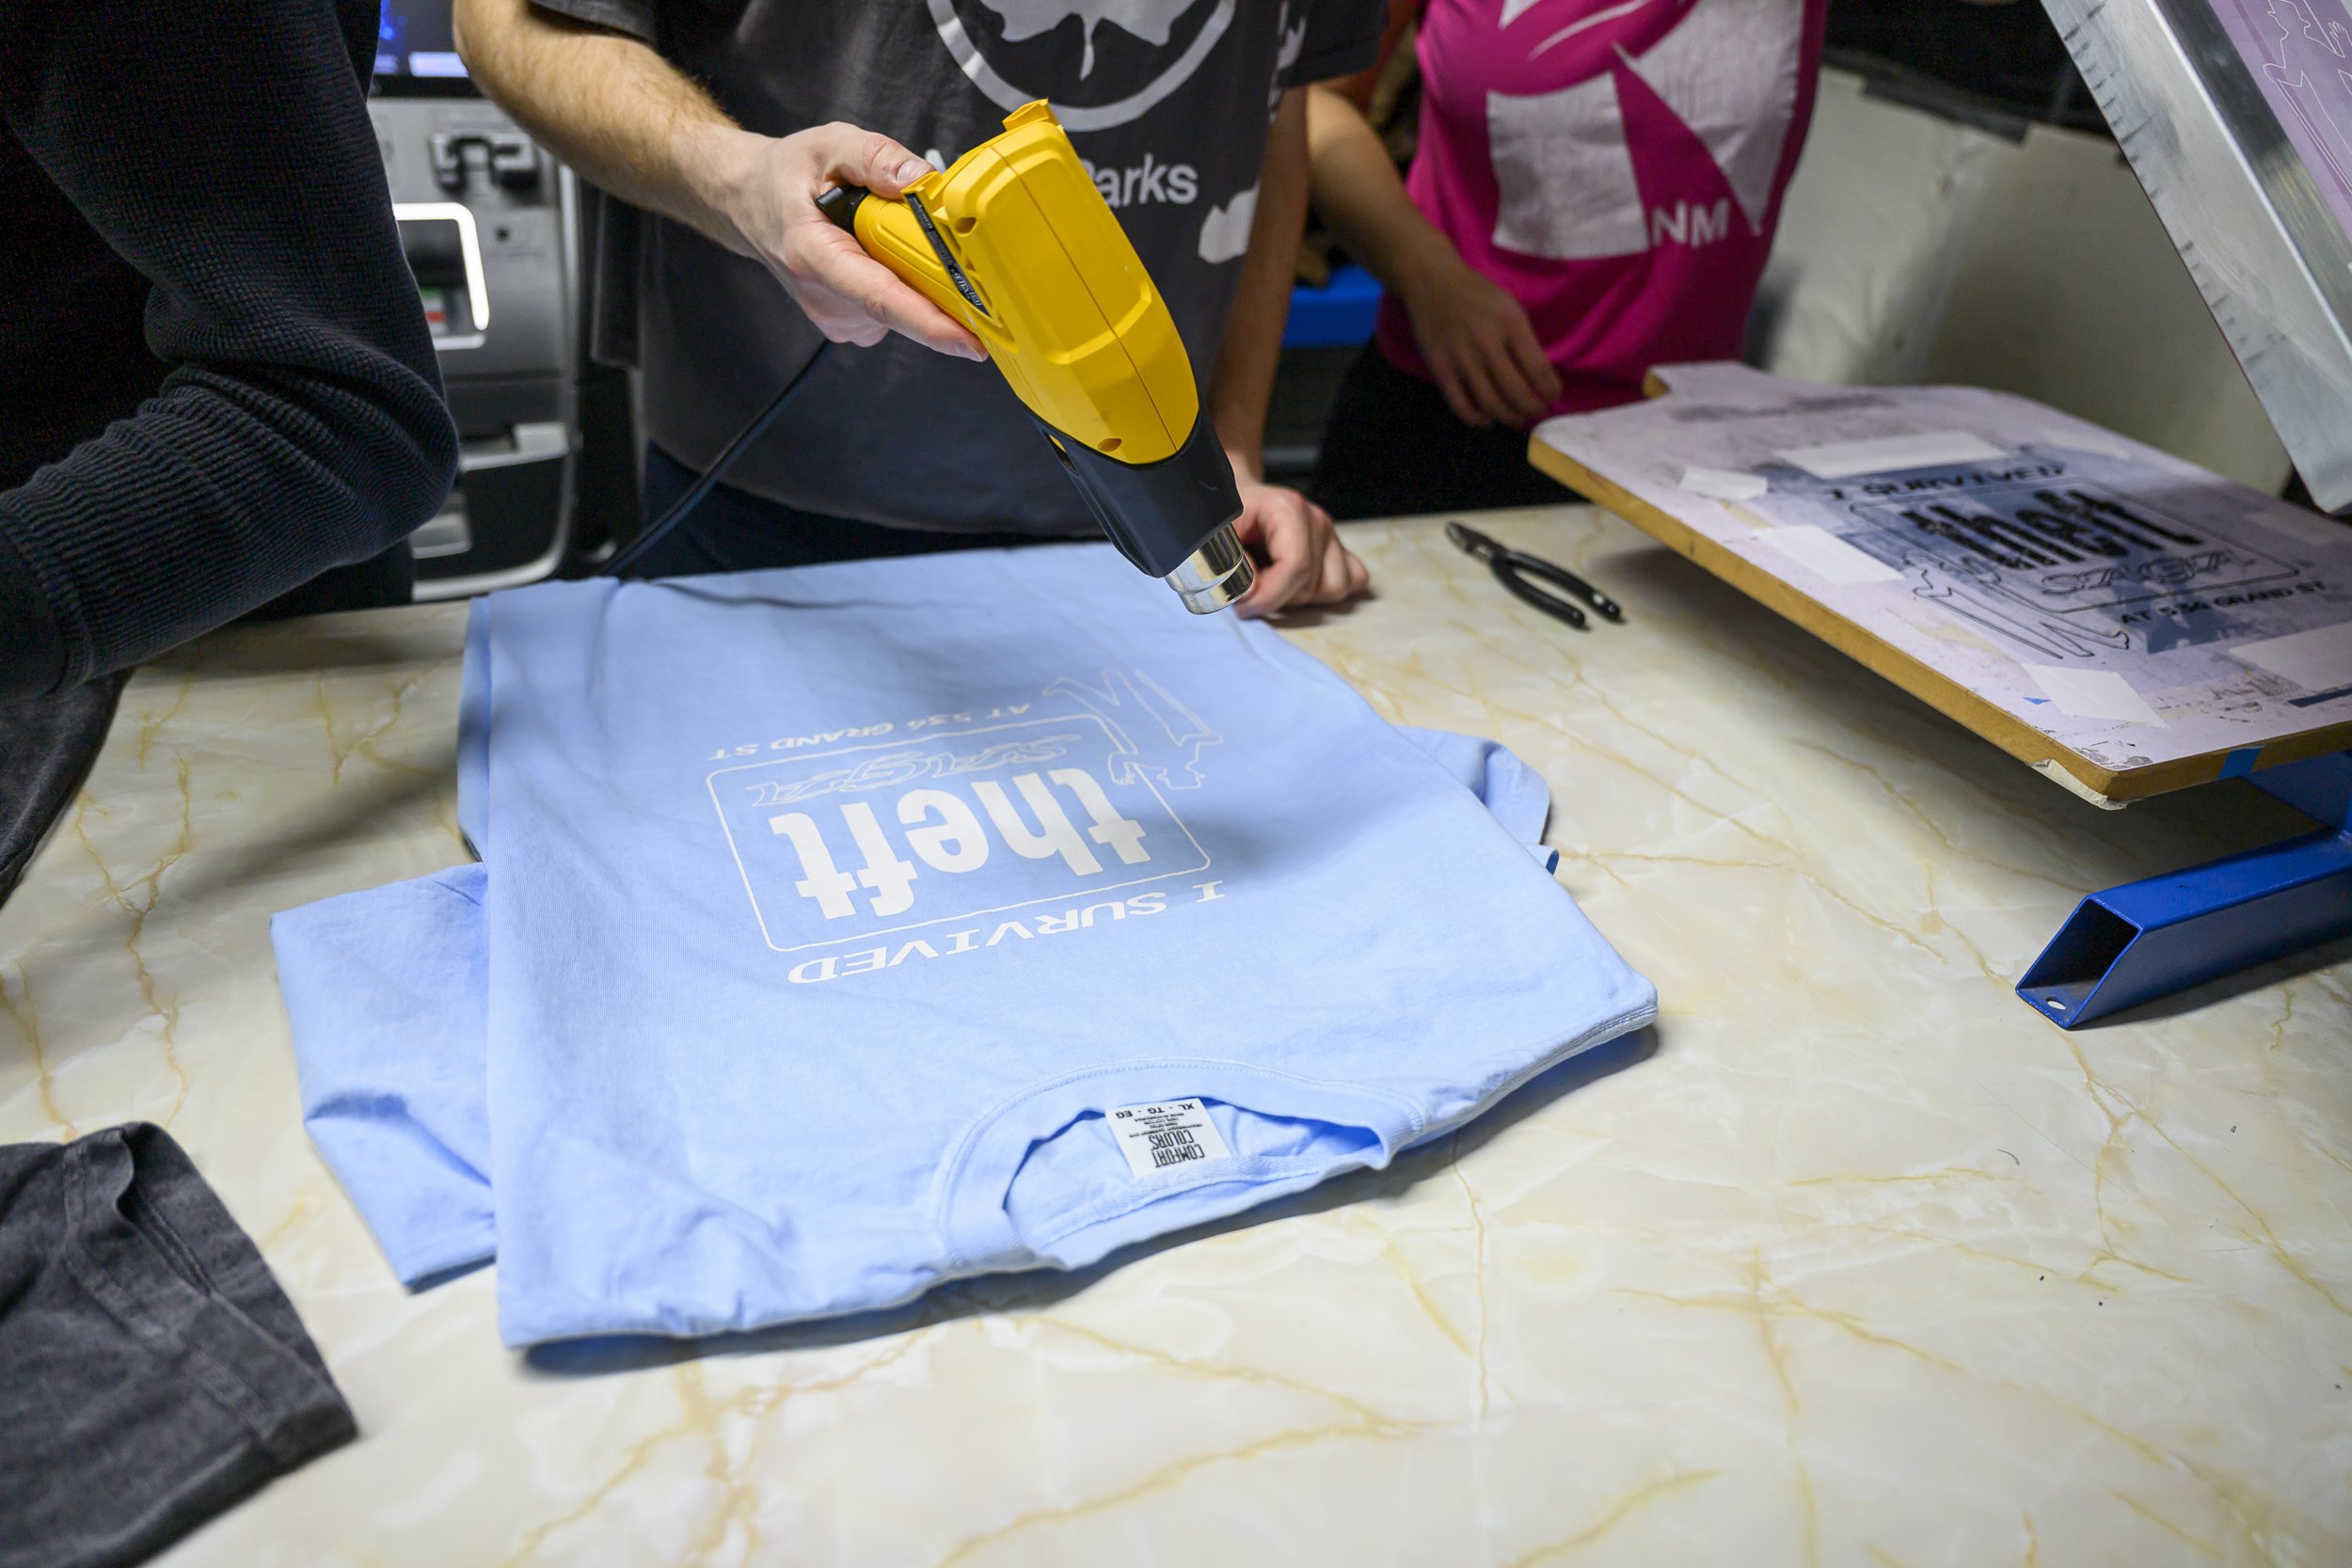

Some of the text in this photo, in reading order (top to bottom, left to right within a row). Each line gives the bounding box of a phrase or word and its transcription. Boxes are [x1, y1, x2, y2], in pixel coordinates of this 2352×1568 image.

[1651, 198, 1731, 248] NM
[1900, 486, 2205, 572] theft
[991, 702, 1032, 720] AT
[771, 721, 895, 751] GRAND
[707, 741, 759, 760] ST
[767, 766, 1152, 921] theft
[787, 879, 1226, 985] I SURVIVED
[1116, 1110, 1133, 1118] EG
[1149, 1130, 1195, 1150] COLORS
[1152, 1144, 1205, 1167] COMFORT
